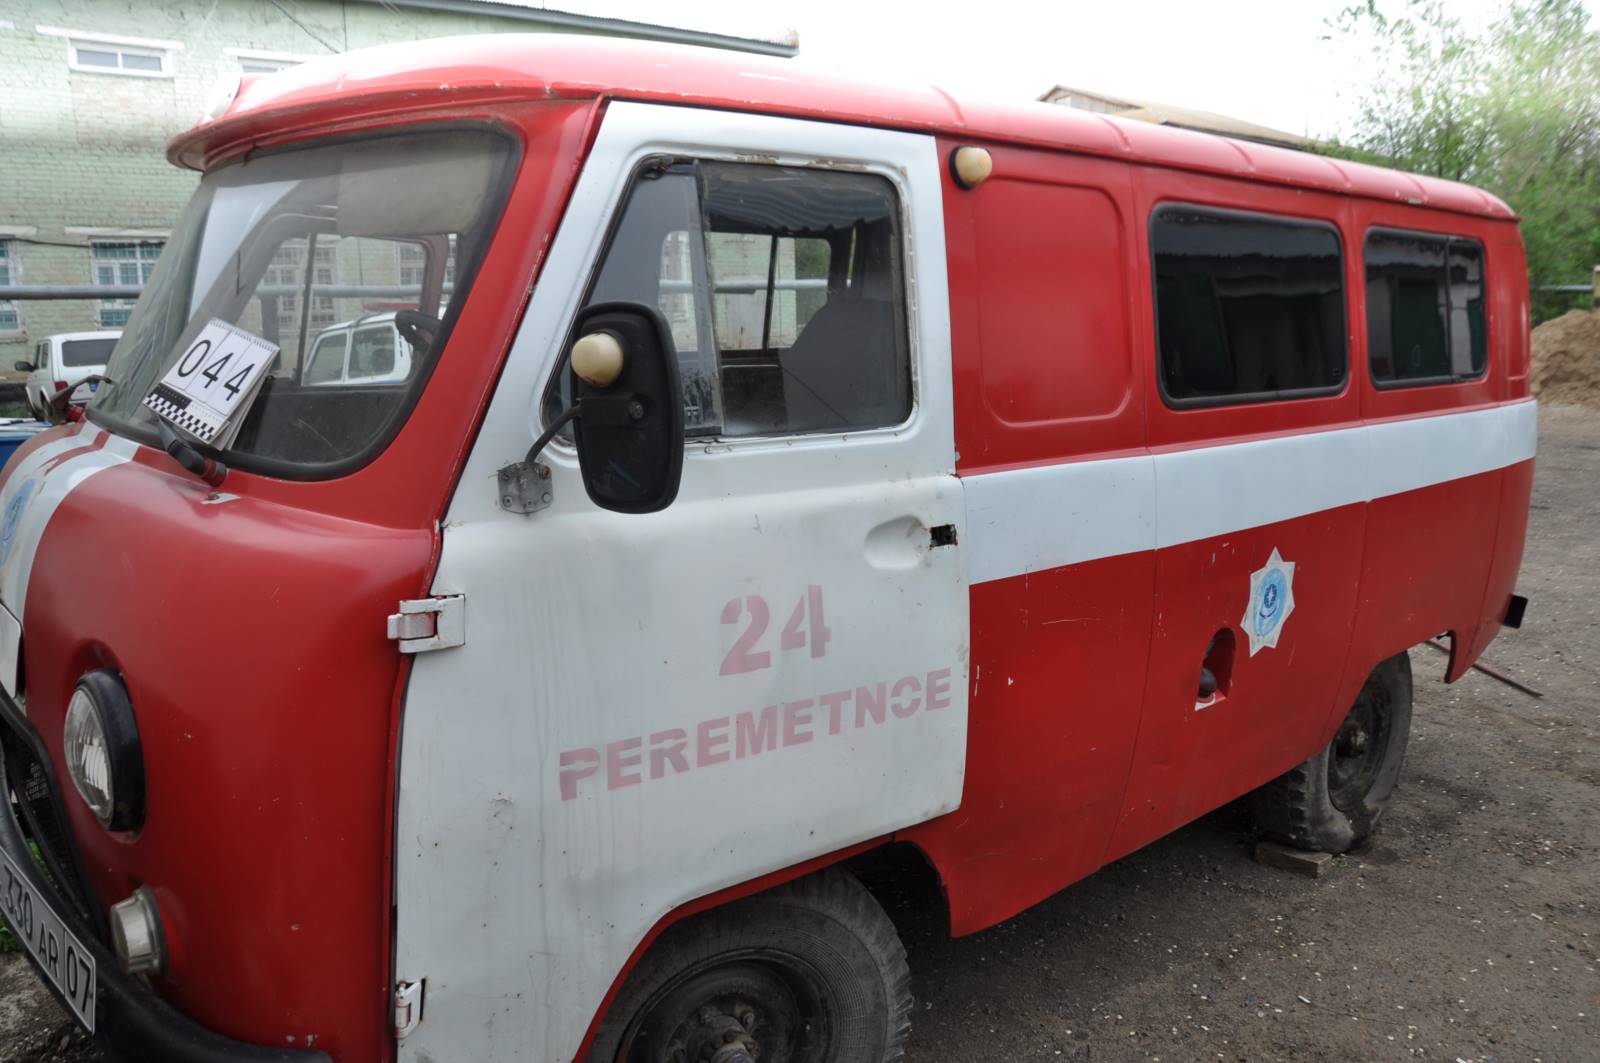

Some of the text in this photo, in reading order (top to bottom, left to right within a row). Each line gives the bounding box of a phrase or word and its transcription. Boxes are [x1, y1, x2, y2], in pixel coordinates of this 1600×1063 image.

[177, 339, 255, 401] 044
[719, 584, 832, 676] 24
[559, 667, 952, 801] PEREMETNOE
[4, 864, 91, 1013] 330 AR 07
